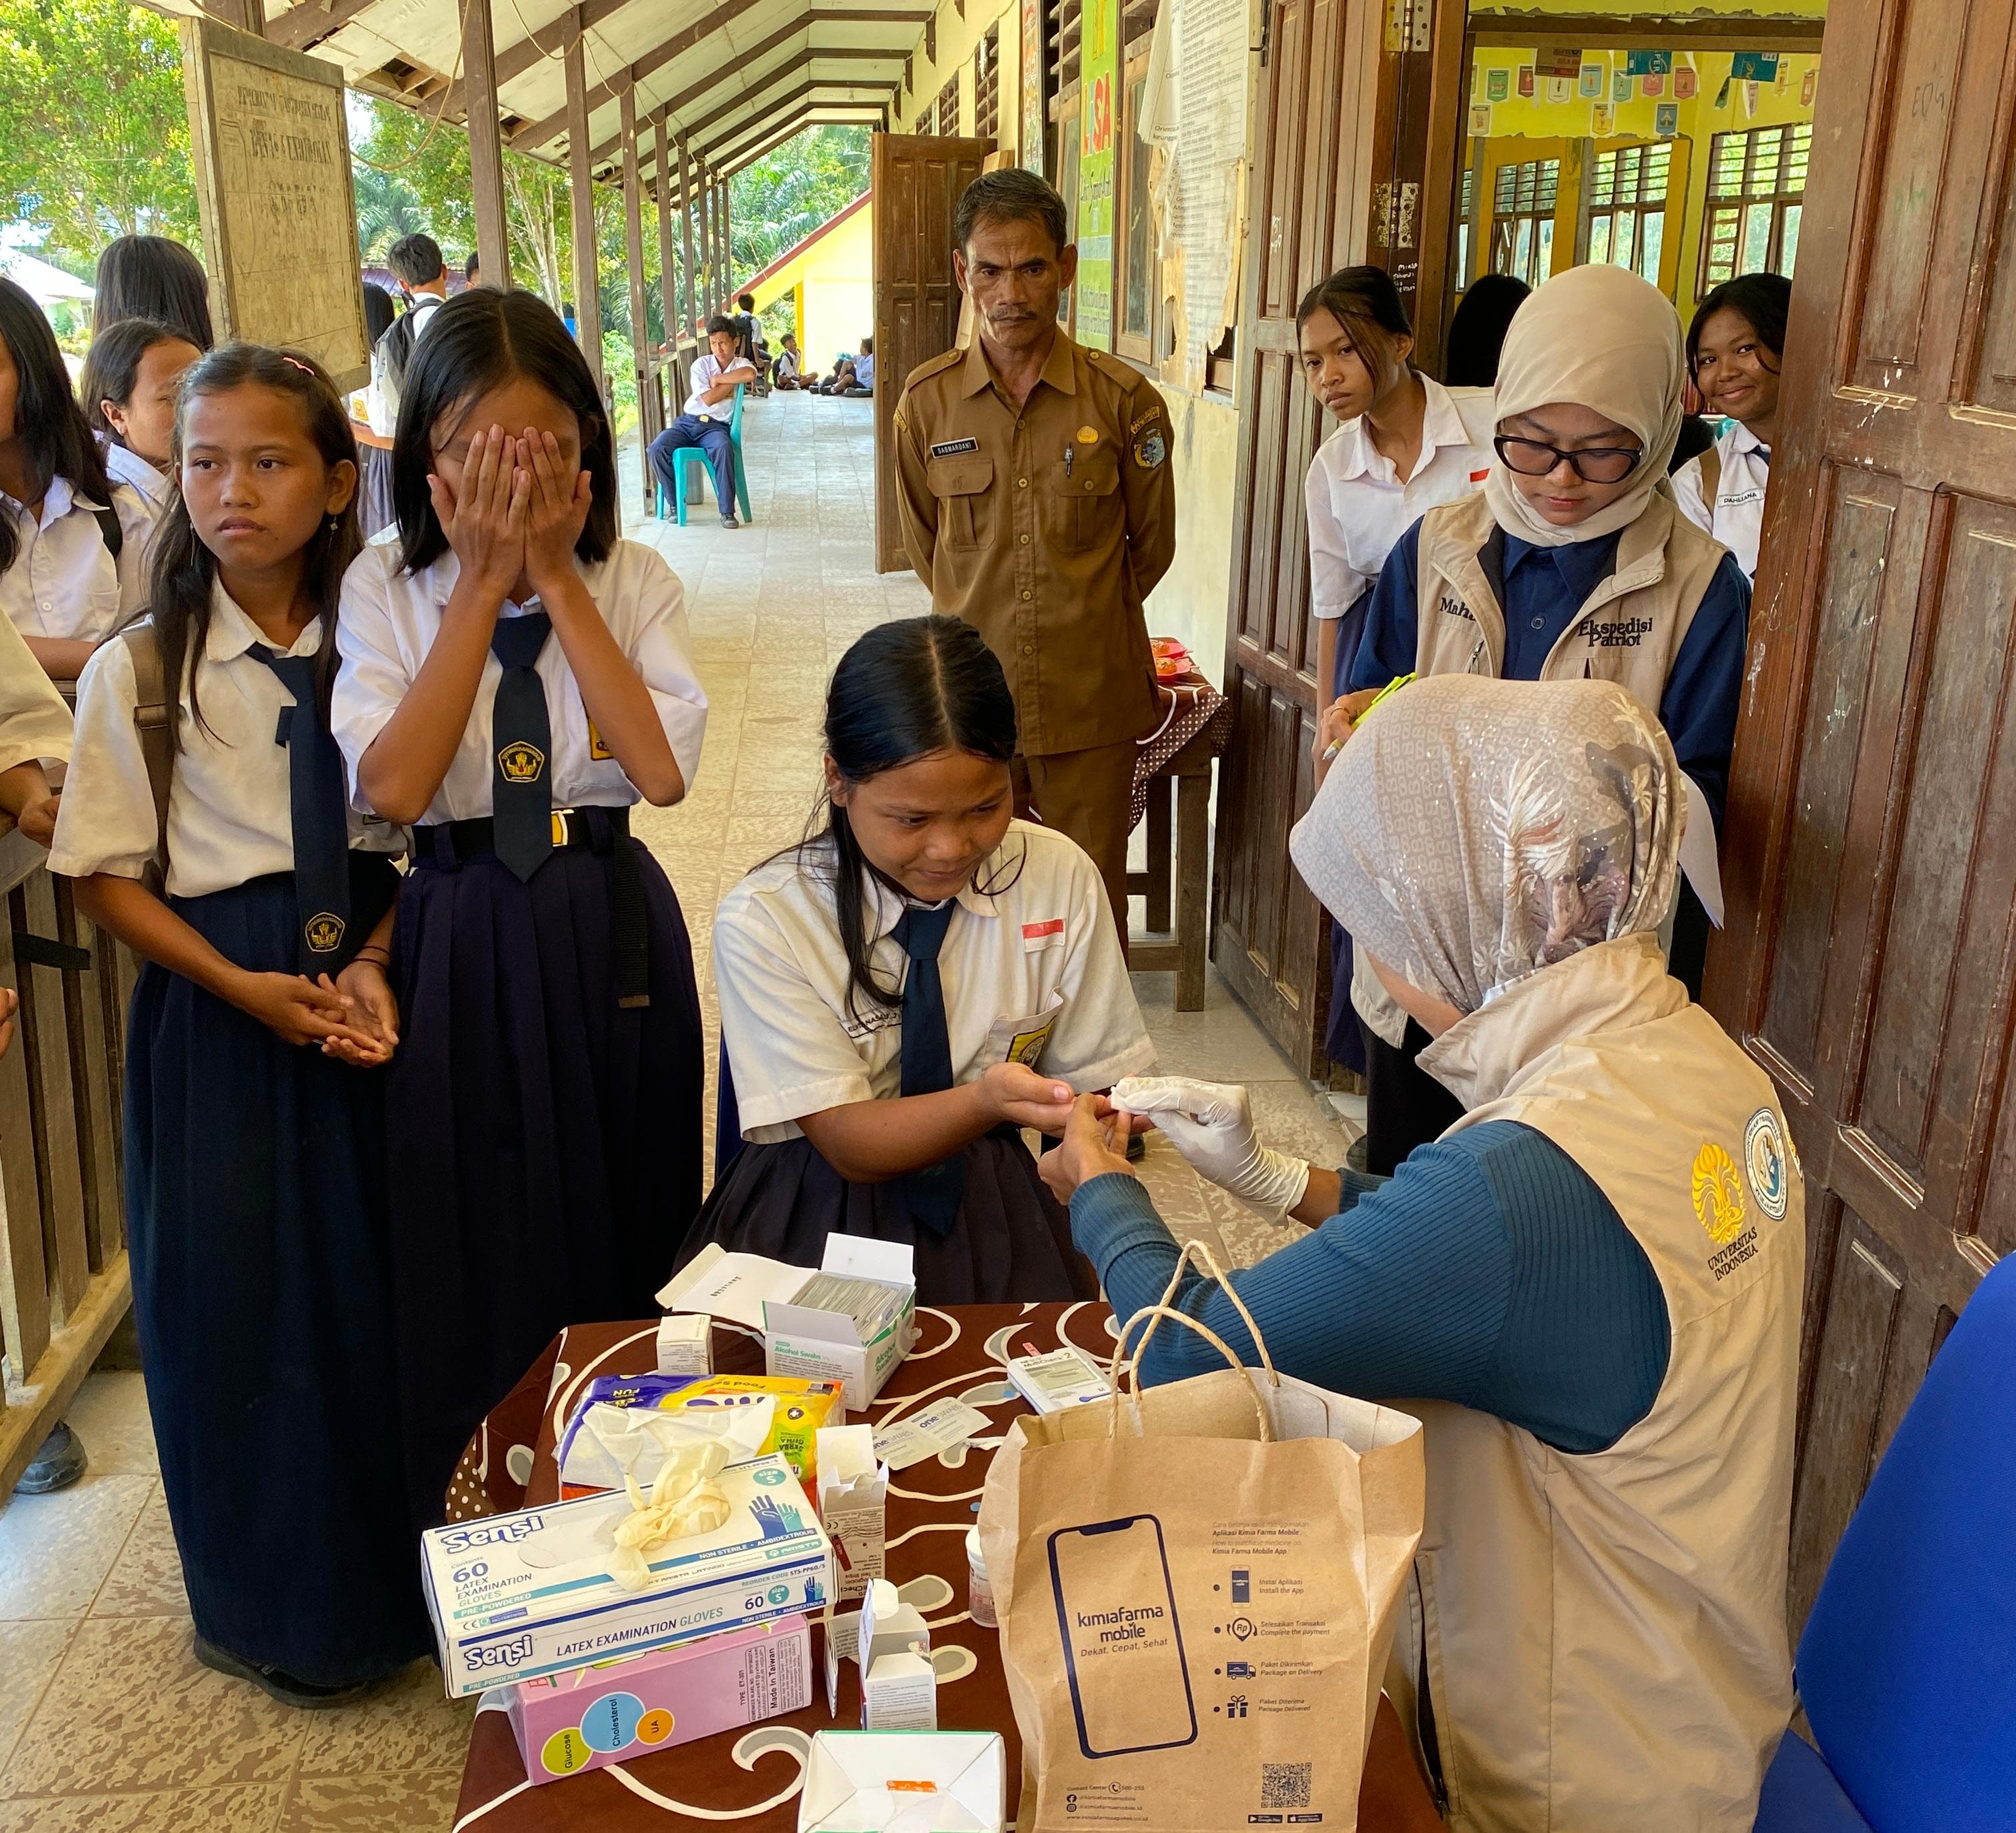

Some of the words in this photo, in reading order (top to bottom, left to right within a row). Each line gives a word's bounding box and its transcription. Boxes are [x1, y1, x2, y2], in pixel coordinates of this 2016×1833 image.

[1082, 70, 1113, 159] LISA
[1578, 617, 1653, 637] Ekspedisi
[1589, 631, 1643, 647] Patriot
[1707, 1226, 1758, 1270] UNIVERSITAS
[1714, 1243, 1759, 1282] INDONESIA
[774, 1345, 799, 1356] Alcohol
[800, 1350, 821, 1360] Swabs
[613, 1388, 641, 1396] FUN
[733, 1380, 767, 1389] Food
[767, 1475, 777, 1484] S
[441, 1515, 545, 1554] Sensi
[699, 1550, 717, 1560] NON
[717, 1544, 747, 1556] STERILE
[757, 1529, 815, 1546] AMBIDEXTROUS
[451, 1556, 484, 1569] Contents
[453, 1562, 489, 1583] 60
[455, 1576, 489, 1592] LATEX
[457, 1573, 532, 1600] EXAMINATION
[742, 1576, 771, 1586] REORDER
[459, 1590, 501, 1607] GLOVES
[461, 1592, 531, 1617] PRE-POWDERED
[745, 1596, 764, 1610] 60
[775, 1593, 782, 1602] S
[755, 1611, 777, 1620] STERILE
[783, 1600, 825, 1613] AMBIDEXTROUS
[1077, 1606, 1164, 1628] kimiafarma
[557, 1638, 593, 1656] LATEX
[596, 1619, 677, 1646] EXAMINATION
[679, 1607, 723, 1627] GLOVES
[1100, 1621, 1146, 1643] mobile
[1236, 1624, 1248, 1632] Rp
[463, 1634, 533, 1671] Sensi
[1081, 1647, 1109, 1658] Dekat,
[1111, 1643, 1141, 1653] Cepat,
[1143, 1638, 1169, 1648] Sehat
[468, 1672, 521, 1691] PRE-POWDERED
[769, 1678, 776, 1686] In
[609, 1698, 621, 1746] Cholesterol
[651, 1720, 660, 1734] UA
